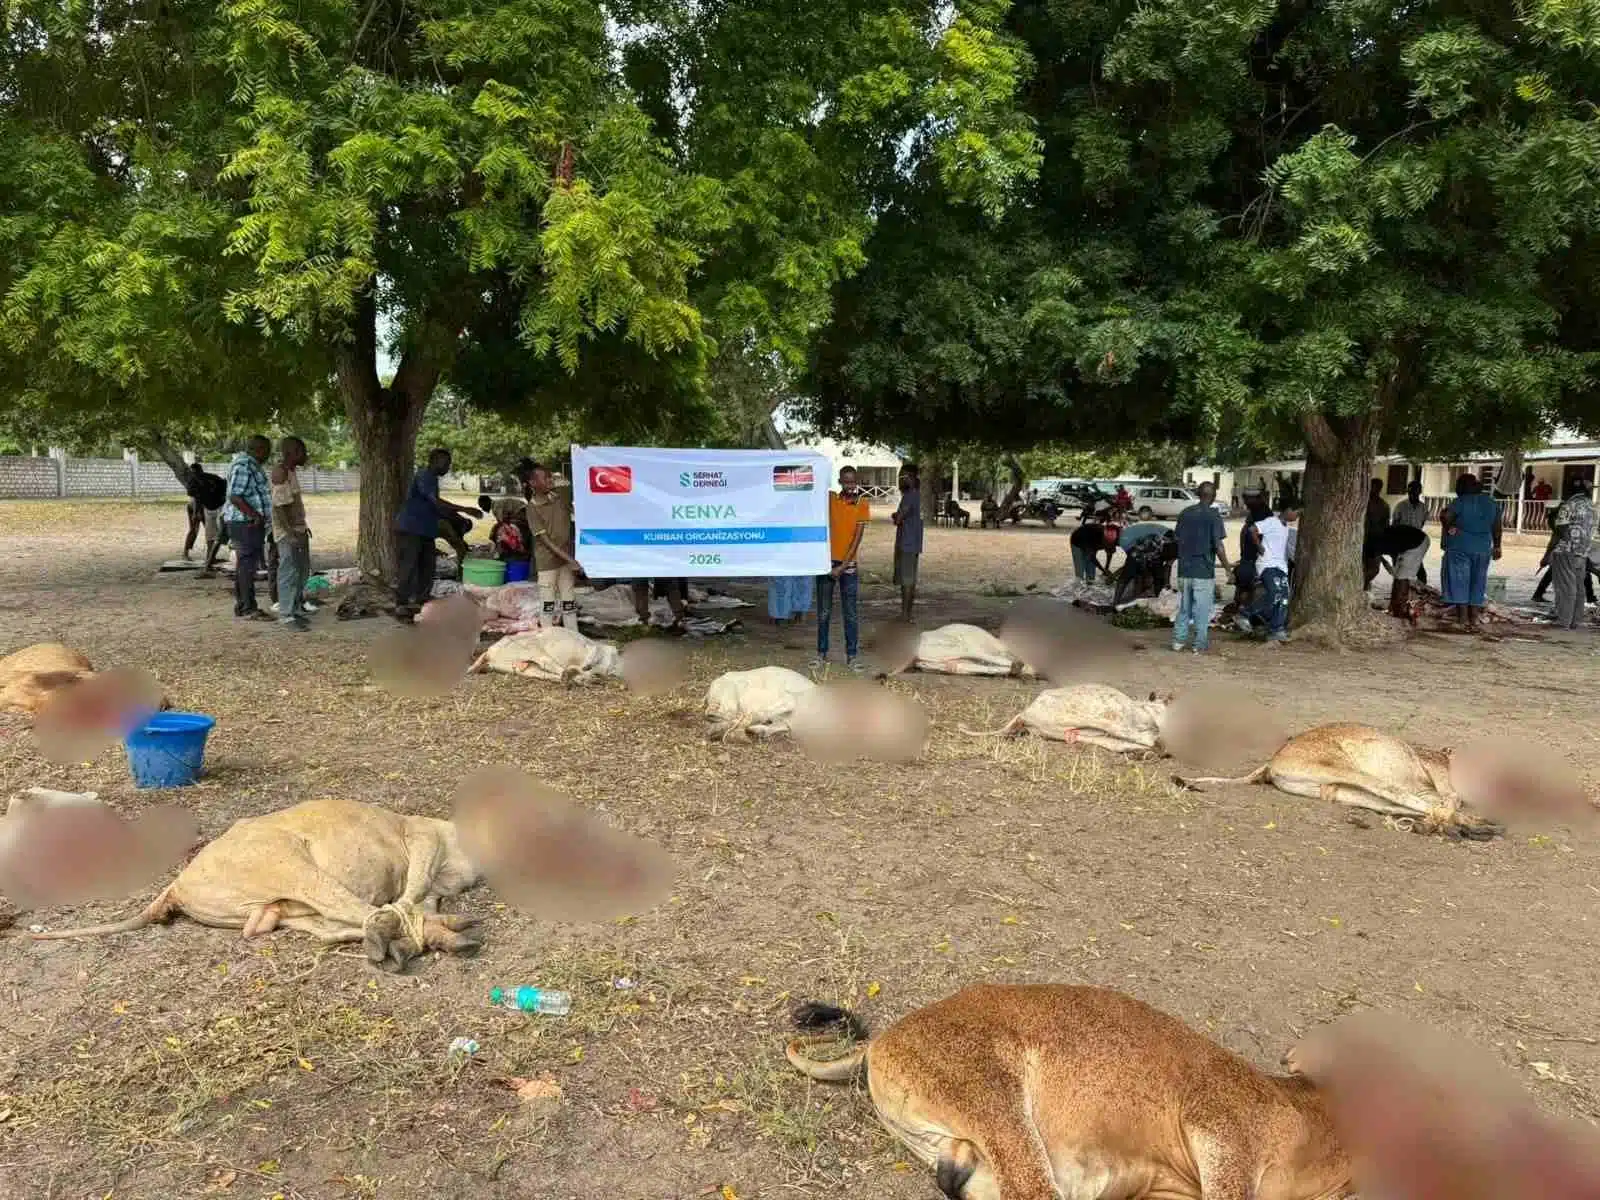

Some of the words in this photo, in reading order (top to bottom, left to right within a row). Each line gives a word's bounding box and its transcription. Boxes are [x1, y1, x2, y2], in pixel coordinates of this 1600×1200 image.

[672, 504, 736, 519] KENYA
[643, 532, 684, 541] KURBAN
[689, 554, 721, 565] 2026
